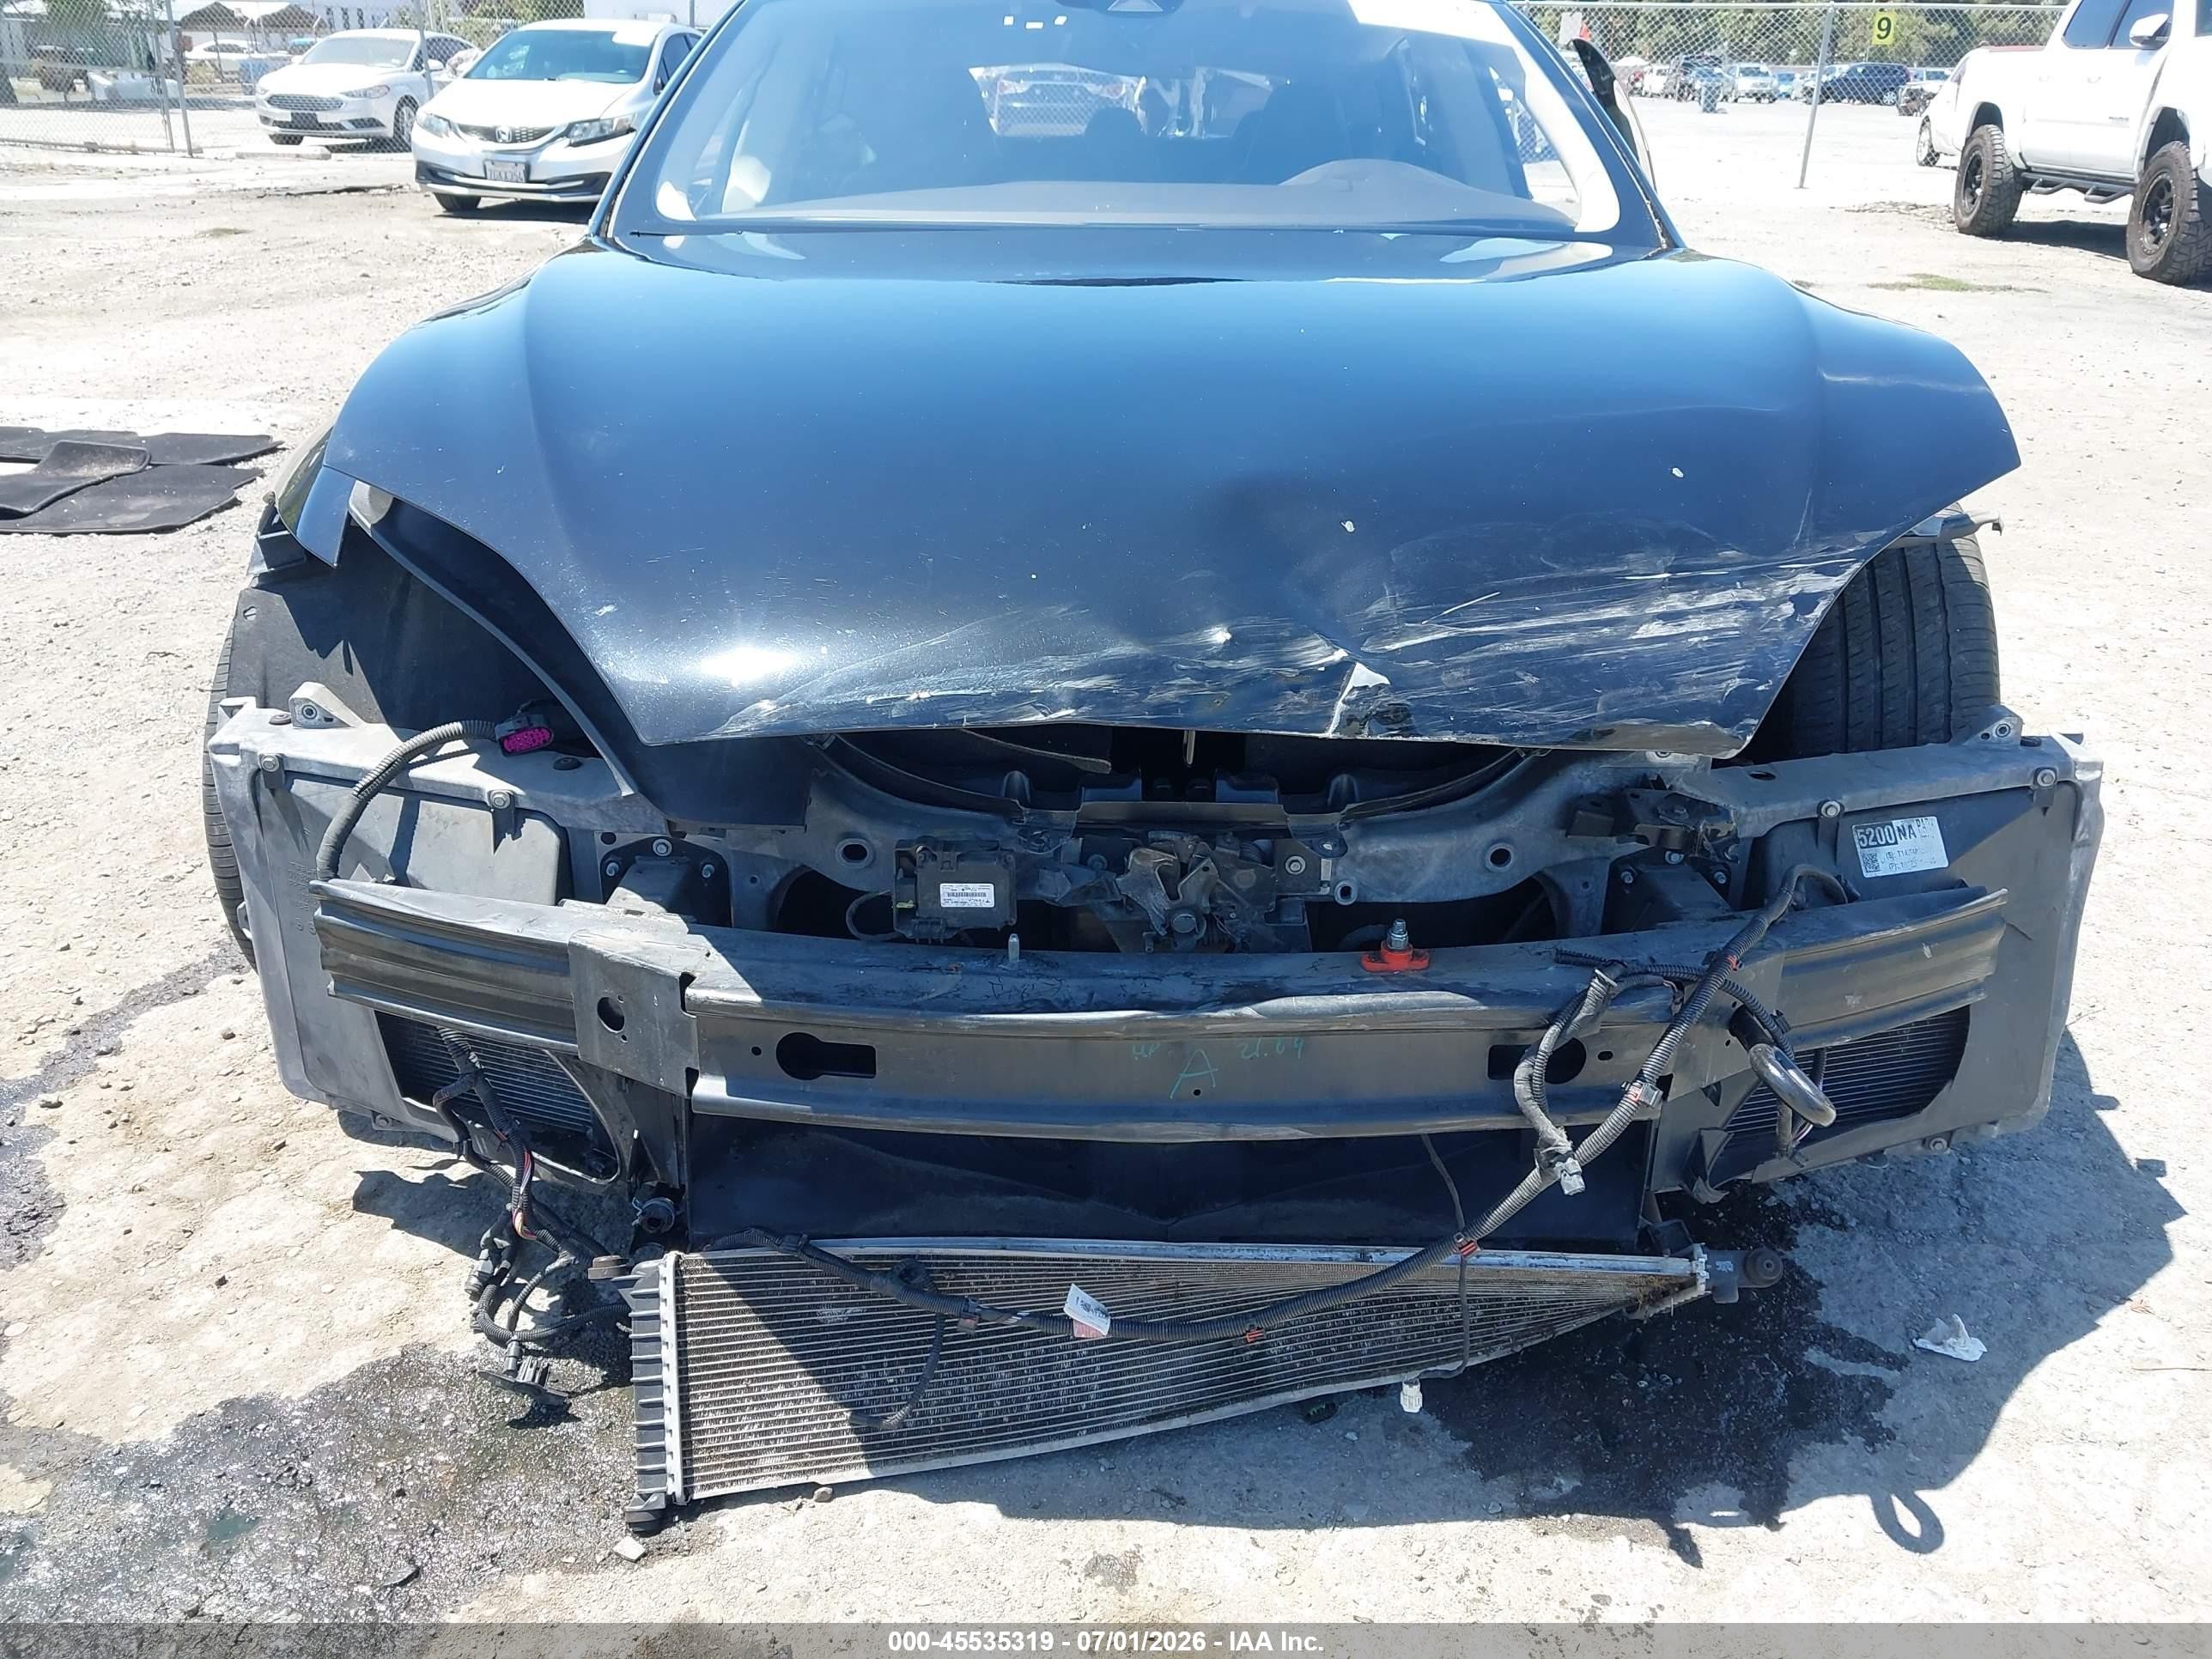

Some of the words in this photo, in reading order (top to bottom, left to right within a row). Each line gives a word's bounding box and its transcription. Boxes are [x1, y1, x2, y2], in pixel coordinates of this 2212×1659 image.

[1876, 17, 1892, 40] 9
[1856, 825, 1895, 848] 5200
[1897, 825, 1917, 841] NA
